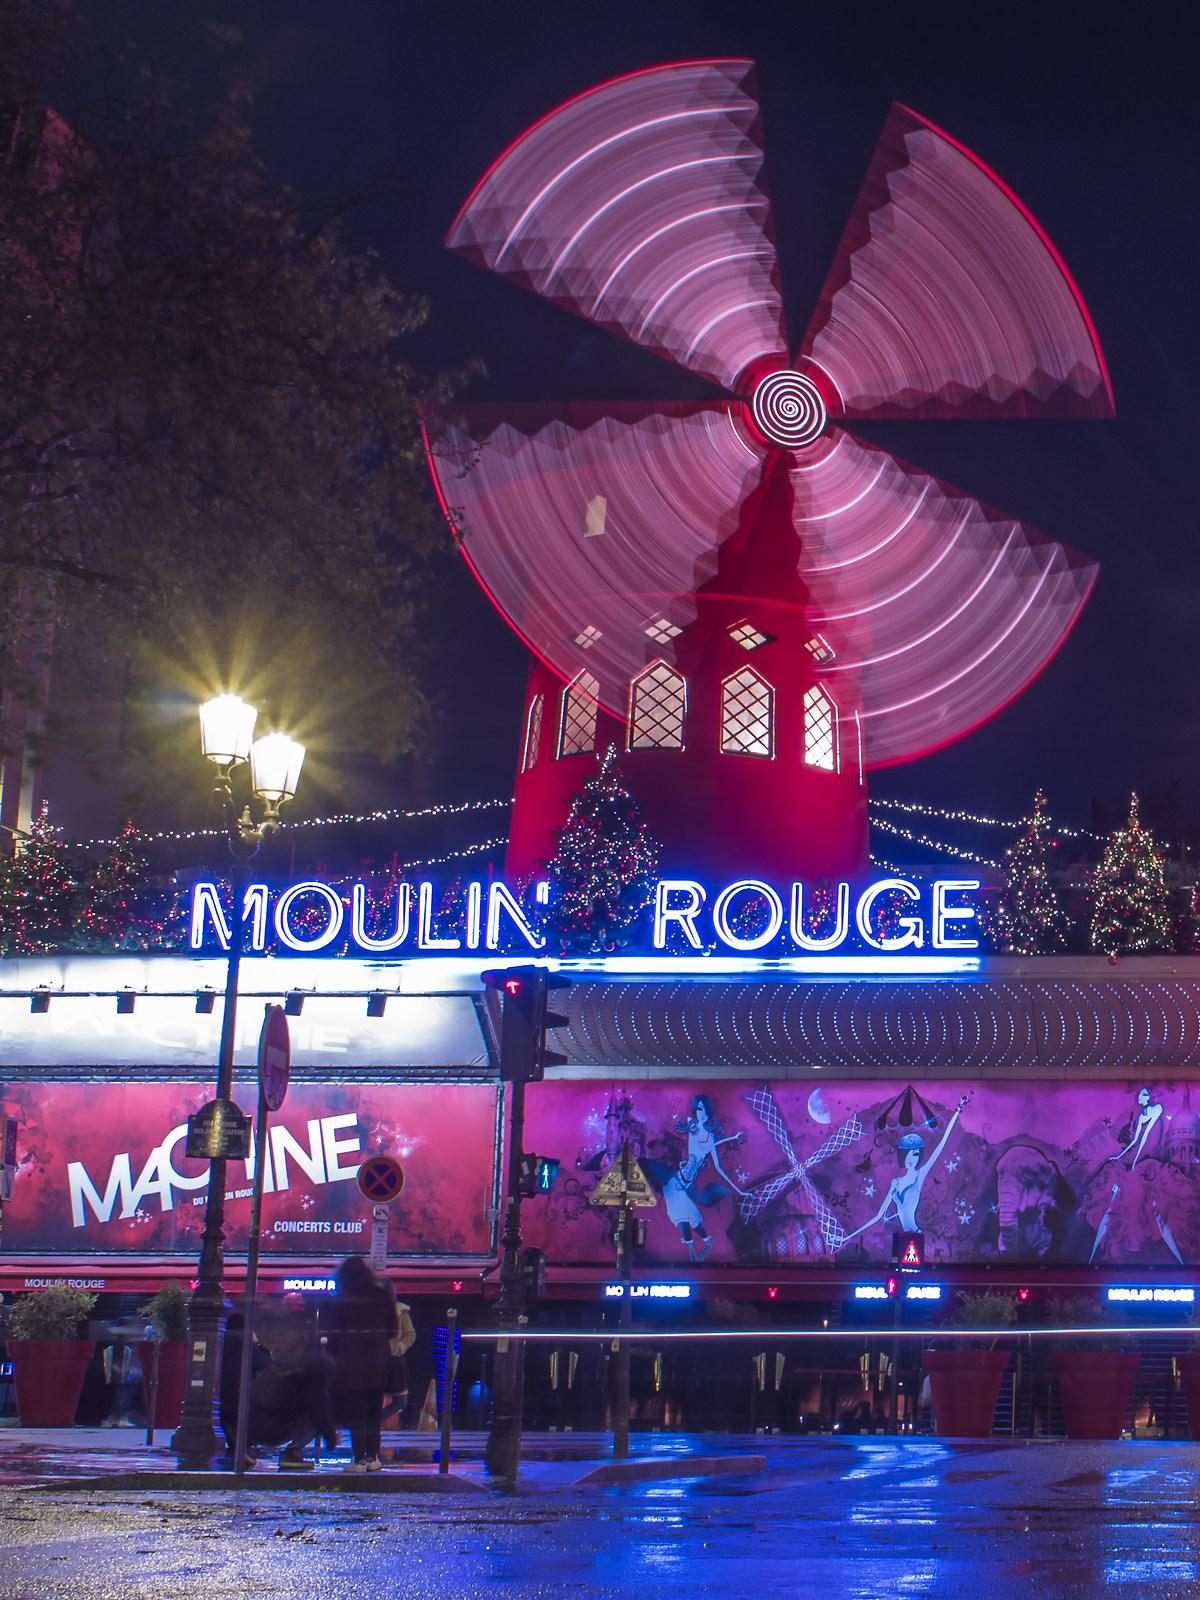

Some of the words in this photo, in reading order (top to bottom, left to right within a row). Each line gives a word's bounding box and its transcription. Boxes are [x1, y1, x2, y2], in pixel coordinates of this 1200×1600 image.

[191, 881, 549, 952] MOULIN
[653, 879, 980, 951] ROUGE
[235, 1187, 254, 1199] ROU
[274, 1220, 331, 1233] CONCERTS
[334, 1221, 363, 1234] CLUB
[24, 1278, 66, 1288] MOULIN
[68, 1279, 105, 1288] ROUGE
[605, 1285, 649, 1297] MOLIN
